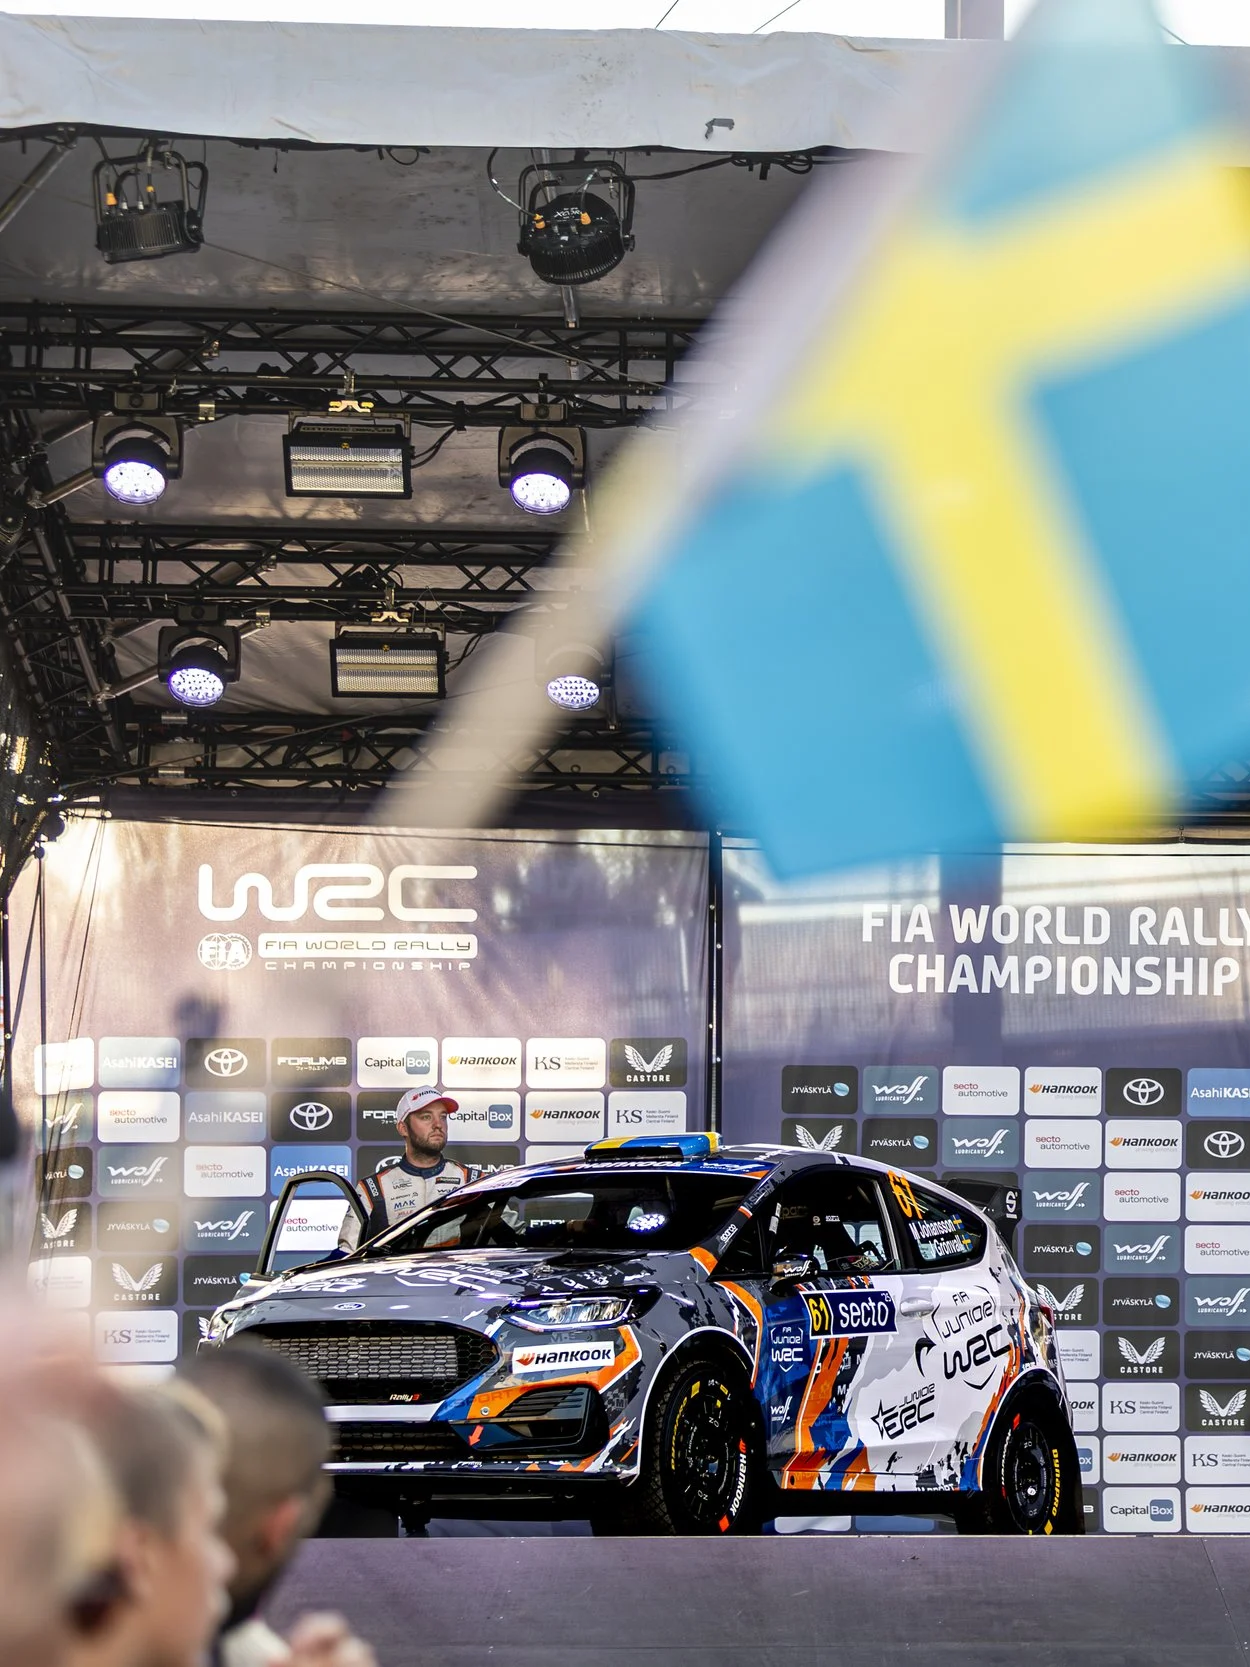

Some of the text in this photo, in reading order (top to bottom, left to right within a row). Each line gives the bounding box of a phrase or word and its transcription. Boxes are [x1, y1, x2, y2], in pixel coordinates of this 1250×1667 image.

[198, 864, 478, 922] WRC
[861, 903, 935, 943] FIA
[949, 903, 1111, 945] WORLD
[265, 940, 471, 951] FIA WORLD RALLY
[264, 961, 471, 970] CHAMPIONSHIP
[888, 953, 1240, 996] CHAMPIONSHIP
[277, 1055, 347, 1066] FORUM8
[534, 1056, 561, 1071] KS
[626, 1074, 671, 1082] CASTORE
[791, 1084, 832, 1095] JYVÄSKYLÄ
[872, 1075, 929, 1105] wolf
[953, 1082, 979, 1090] secto
[958, 1089, 1008, 1098] automotive
[109, 1108, 136, 1116] secto
[616, 1109, 643, 1124] KS
[114, 1115, 168, 1124] automotive
[870, 1137, 911, 1148] JYVÄSKYLÄ
[952, 1129, 1010, 1158] wolf
[1035, 1135, 1061, 1143] secto
[1040, 1142, 1090, 1151] automotive
[107, 1156, 168, 1187] wolf
[195, 1163, 223, 1171] secto
[201, 1170, 254, 1179] automotive
[887, 1169, 923, 1219] 61
[1032, 1181, 1091, 1211] wolf
[1114, 1188, 1140, 1197] secto
[1119, 1196, 1169, 1204] automotive
[194, 1211, 255, 1241] wolf
[286, 1224, 339, 1233] automotive
[908, 1216, 956, 1240] M Johansson
[935, 1233, 963, 1257] Grönvall
[1033, 1243, 1074, 1254] JYVÄSKYLÄ
[1113, 1234, 1171, 1264] wolf
[1195, 1241, 1220, 1249] secto
[1200, 1248, 1250, 1257] automotive
[193, 1274, 237, 1286] JYVÄSKYLÄ
[113, 1293, 160, 1301] CASTORE
[952, 1291, 970, 1306] FIA
[1112, 1296, 1154, 1307] JYVÄSKYLÄ
[807, 1296, 830, 1332] 61
[839, 1297, 890, 1328] secto
[1053, 1312, 1083, 1321] STORE
[942, 1299, 994, 1338] JUNIOR
[104, 1329, 132, 1344] KS
[771, 1347, 803, 1362] WRC
[943, 1324, 1012, 1380] WRC
[1193, 1349, 1235, 1360] JYVÄSKYLÄ
[1120, 1366, 1164, 1374] CASTORE
[389, 1393, 421, 1402] Rally3
[899, 1383, 936, 1408] JUNIOR
[1109, 1400, 1136, 1414] KS
[1201, 1418, 1245, 1426] CASTORE
[1192, 1453, 1218, 1467] KS
